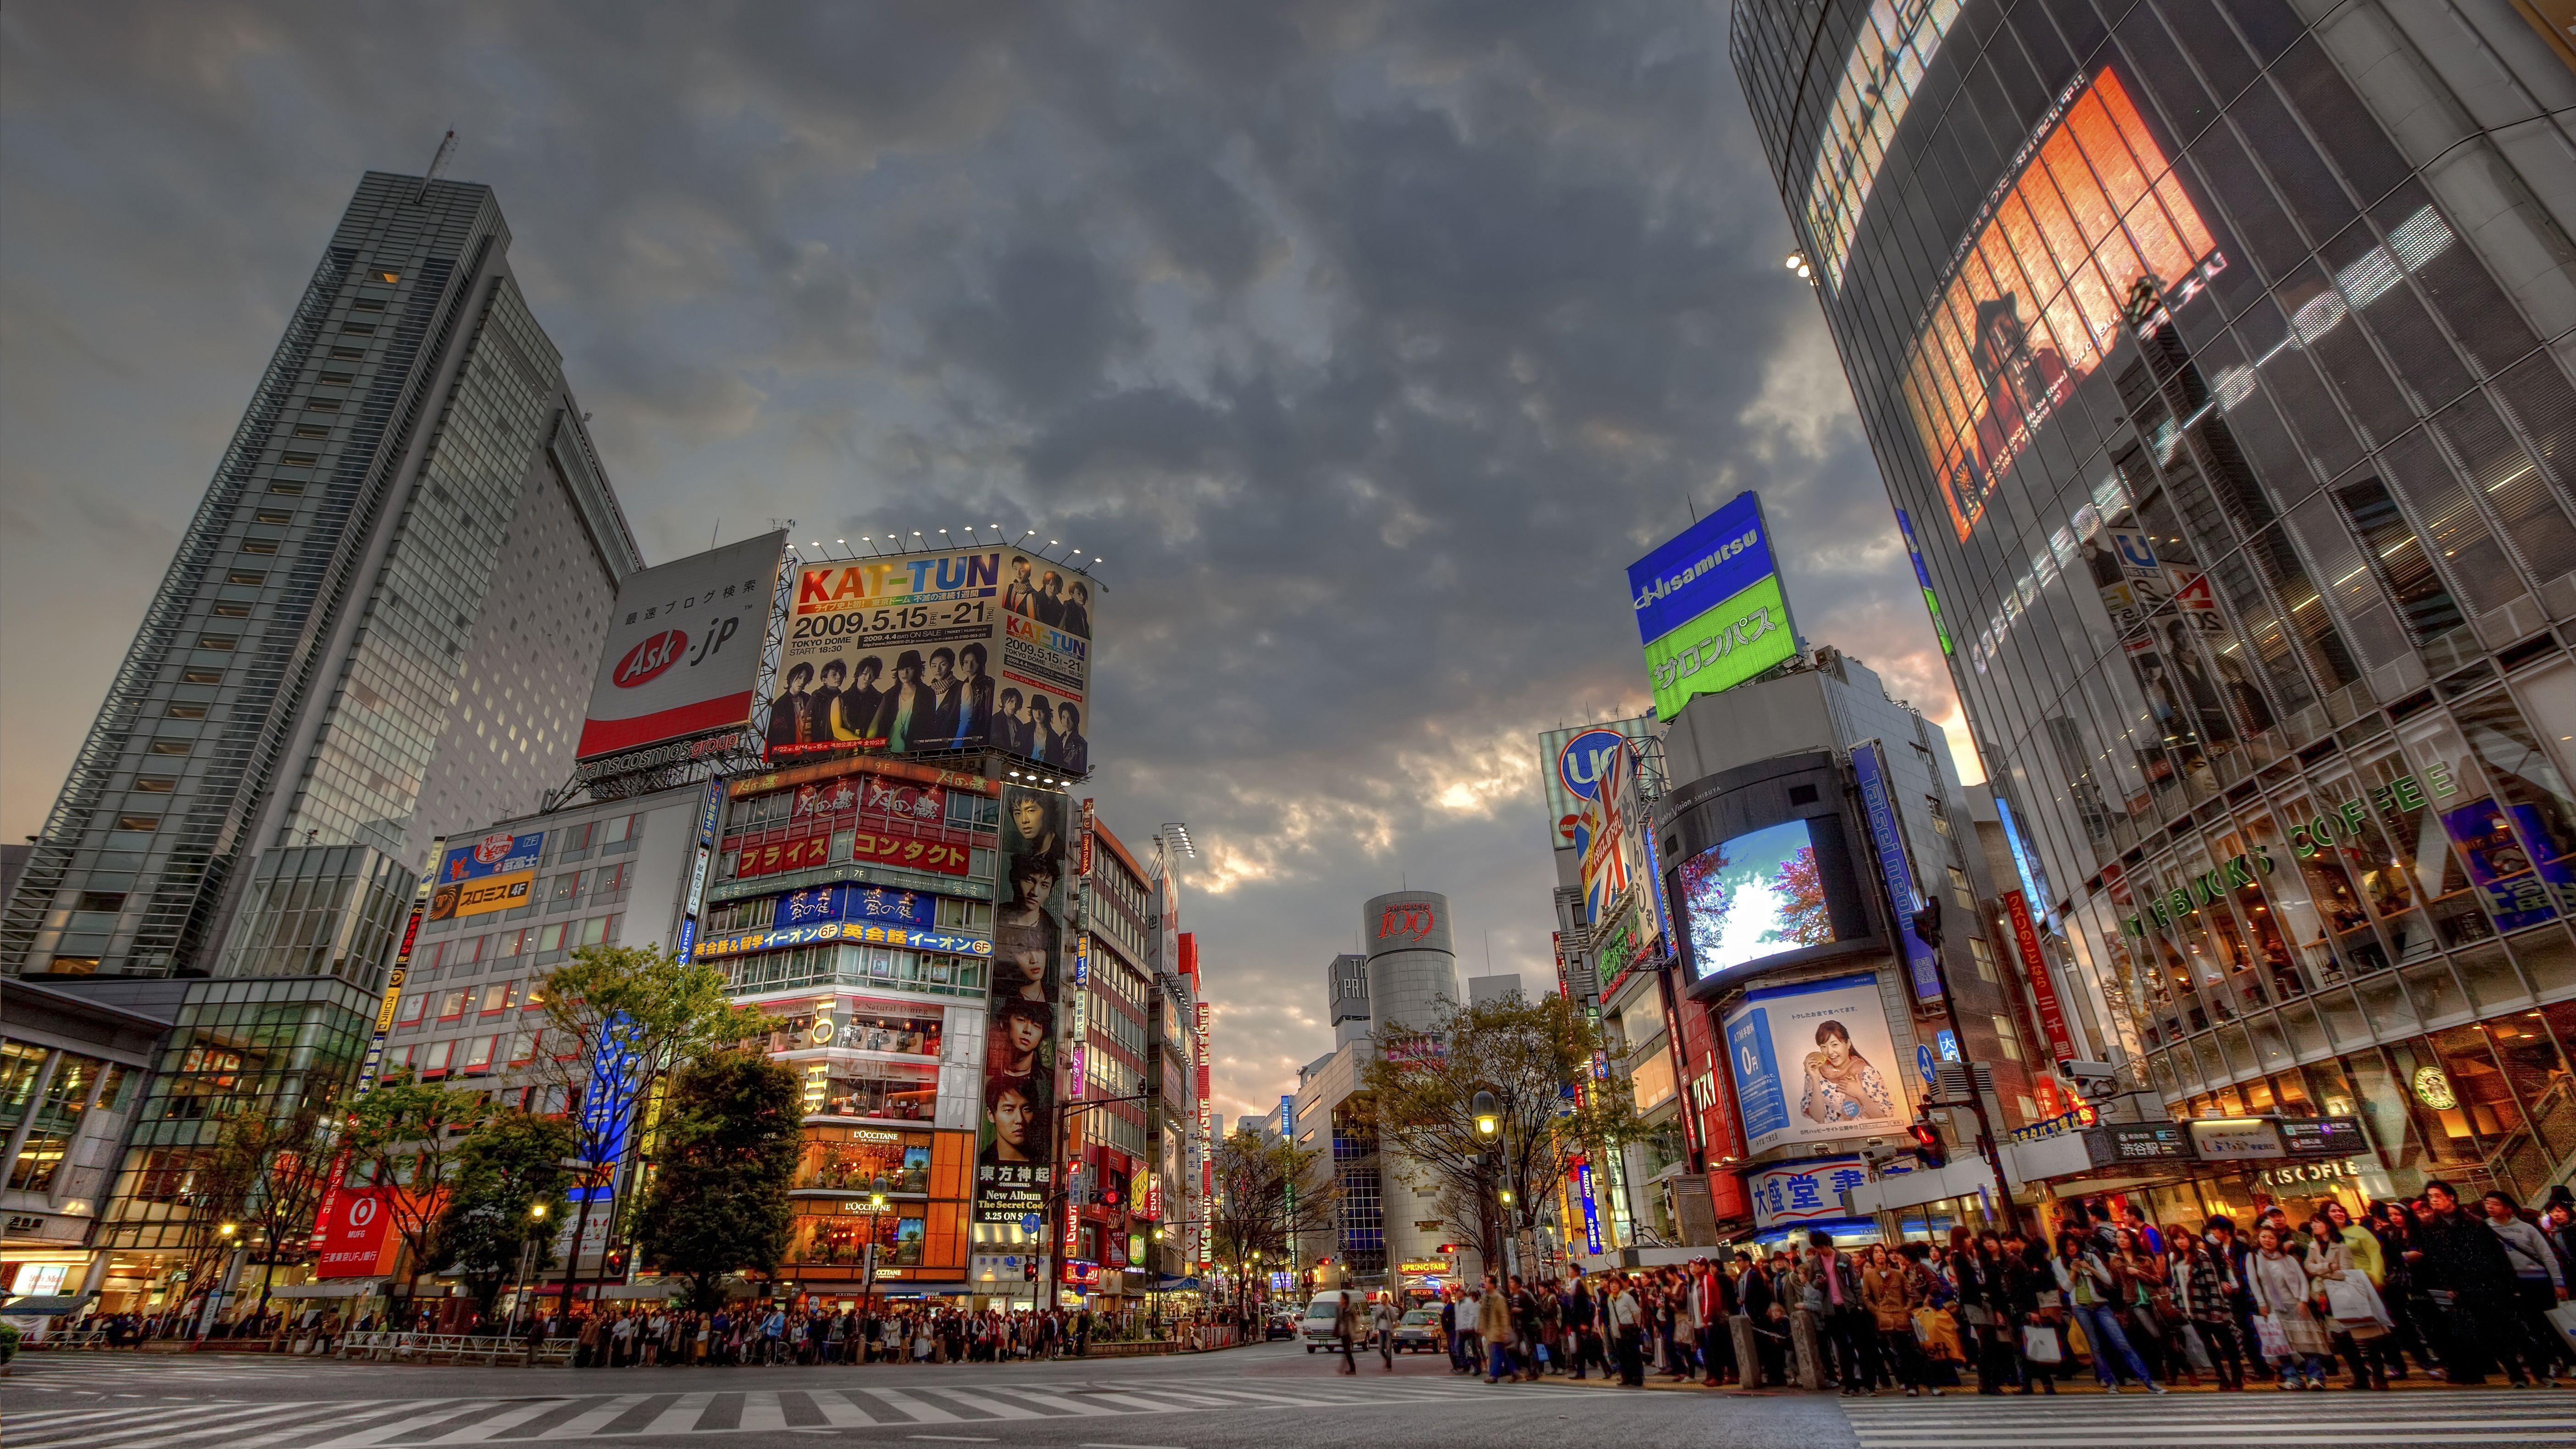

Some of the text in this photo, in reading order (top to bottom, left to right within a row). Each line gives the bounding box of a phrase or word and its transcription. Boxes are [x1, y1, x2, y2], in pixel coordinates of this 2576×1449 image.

[2072, 350, 2086, 367] OW
[799, 553, 1000, 604] KAT-TUN
[1633, 529, 1758, 611] Hisamitsu
[624, 579, 757, 626] 最速ブログ検索
[815, 589, 979, 612] ライブ史上初! 東京ドーム 不滅の連続1週間
[793, 606, 927, 639] 2009.5.15
[1006, 615, 1085, 657] KAT-TUN
[789, 645, 842, 656] START 18:30
[792, 636, 852, 648] TOKYO DOME
[1005, 637, 1059, 664] 2009.5.15
[1654, 607, 1776, 689] サロンパス
[1005, 647, 1083, 679] TOKYO DOME START 18:30
[575, 733, 739, 781] transcosmos group
[1654, 786, 1721, 827] Mighty Vision SHIBUYA
[502, 854, 537, 872] 武富士
[741, 834, 965, 871] プライス コンタクト
[1862, 770, 1914, 932] Taisei neon
[460, 883, 526, 907] プロミス 4F
[690, 865, 704, 906] 献血ルーム
[1385, 903, 1431, 912] SHIBUYA
[842, 923, 971, 951] 英会話イーオン
[974, 942, 989, 952] 6F
[1377, 909, 1435, 943] 109
[694, 926, 836, 957] 英会話&留学イーオン 6F
[1351, 959, 1368, 978] TH
[2009, 895, 2073, 1057] クスリのことなら 三千里
[1344, 978, 1370, 999] PRI
[864, 1003, 929, 1016] Natural Dining
[1792, 1006, 1858, 1020] トクしたお金で食べてます。
[1741, 1046, 1758, 1075] 0円
[854, 1130, 898, 1140] L'OCCITANE
[2121, 1142, 2160, 1157] 渋谷駅
[980, 1165, 1049, 1183] 東方神起
[1582, 1170, 1592, 1198] MIZUHO
[978, 1200, 992, 1209] The
[993, 1200, 1025, 1209] Secret
[986, 1190, 1041, 1200] New Album
[985, 1211, 1002, 1221] 3.25
[1003, 1212, 1016, 1221] ON
[1066, 1205, 1077, 1242] ドラッグ
[1187, 1194, 1196, 1252] マルナン
[347, 1229, 366, 1238] MUFG
[1588, 1217, 1597, 1248] みずほ銀行
[322, 1251, 377, 1263] 三菱東京UFJ銀行
[1066, 1246, 1075, 1257] 薬
[1401, 1262, 1447, 1273] SPRING FAIR
